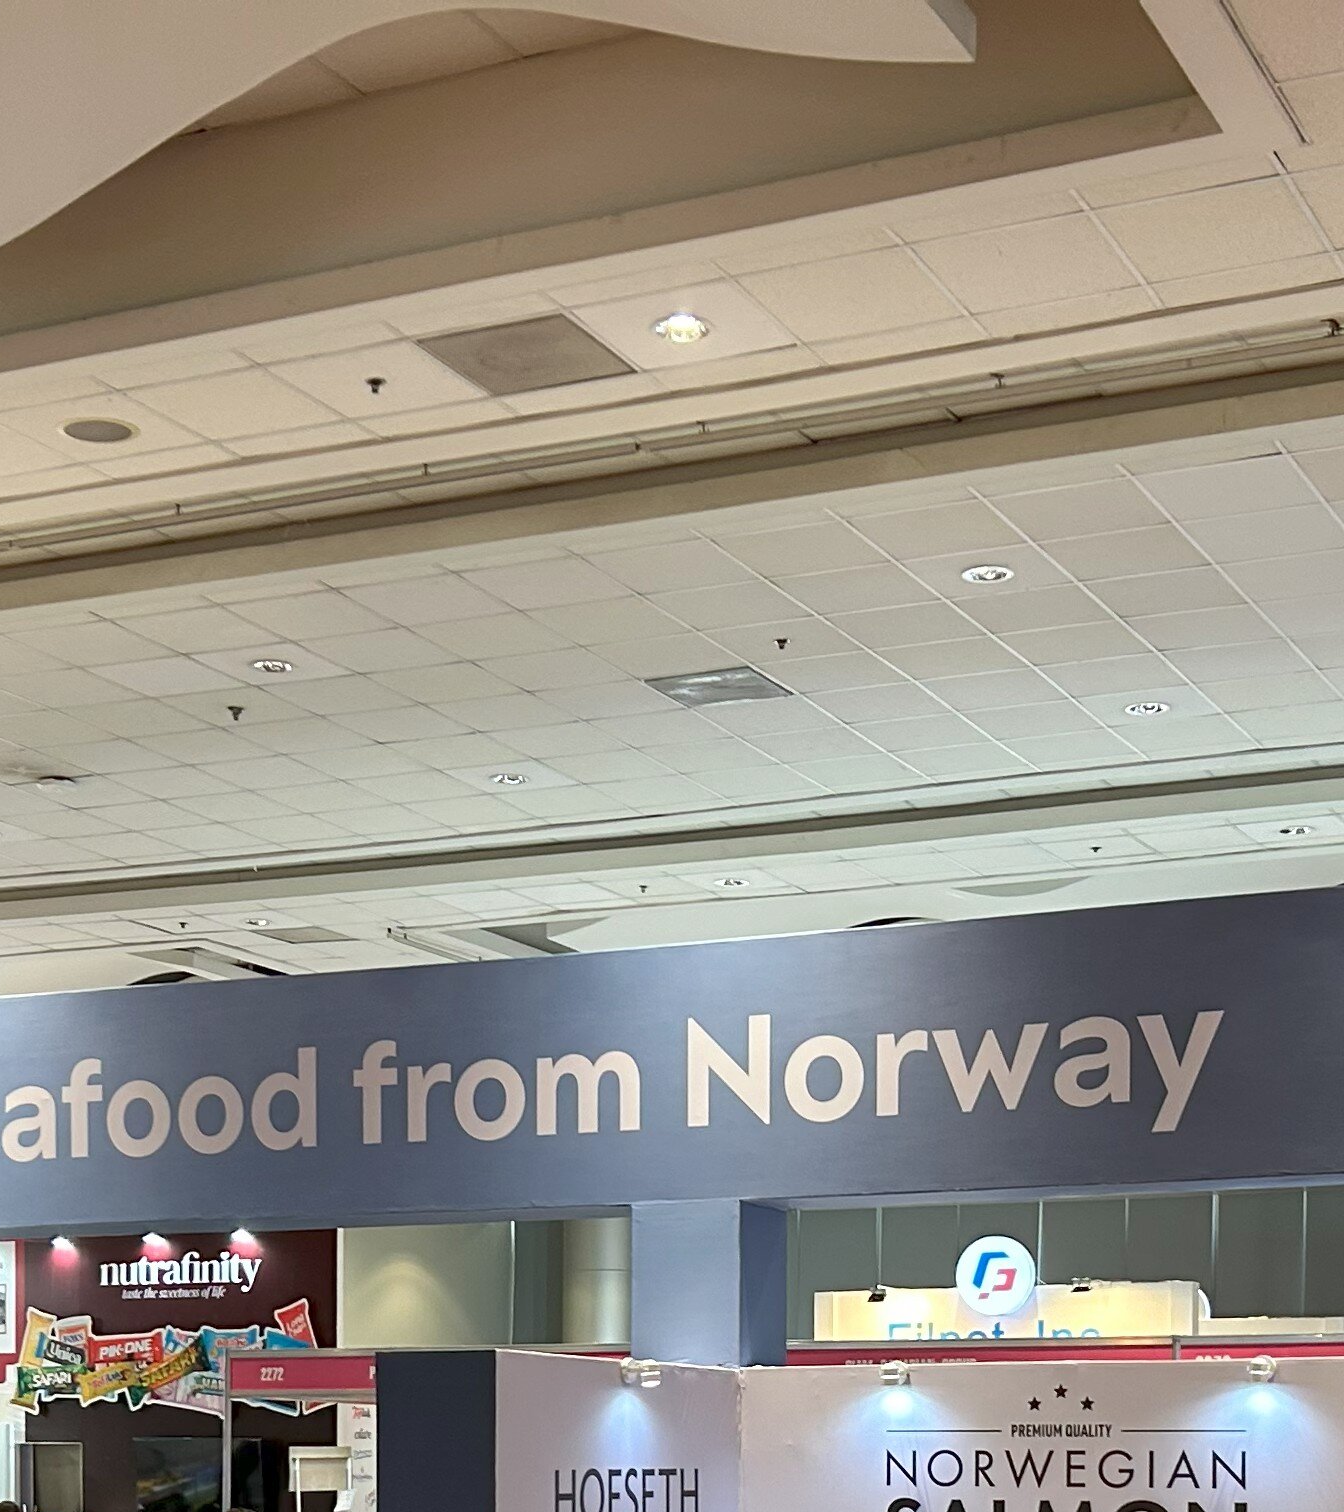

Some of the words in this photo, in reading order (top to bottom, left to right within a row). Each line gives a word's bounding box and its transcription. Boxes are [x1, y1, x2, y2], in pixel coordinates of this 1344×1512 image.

[352, 1039, 642, 1145] from
[686, 1009, 1225, 1133] Norway
[99, 1251, 263, 1293] nutrafinity
[143, 1287, 158, 1299] the
[158, 1287, 201, 1299] sweetness
[201, 1286, 211, 1299] of
[211, 1285, 227, 1299] life
[31, 1370, 73, 1388] SAFARI
[260, 1367, 284, 1381] 2272
[1010, 1424, 1064, 1438] PREMIUM
[1065, 1424, 1113, 1438] QUALITY
[885, 1448, 1247, 1490] NORWEGIAN
